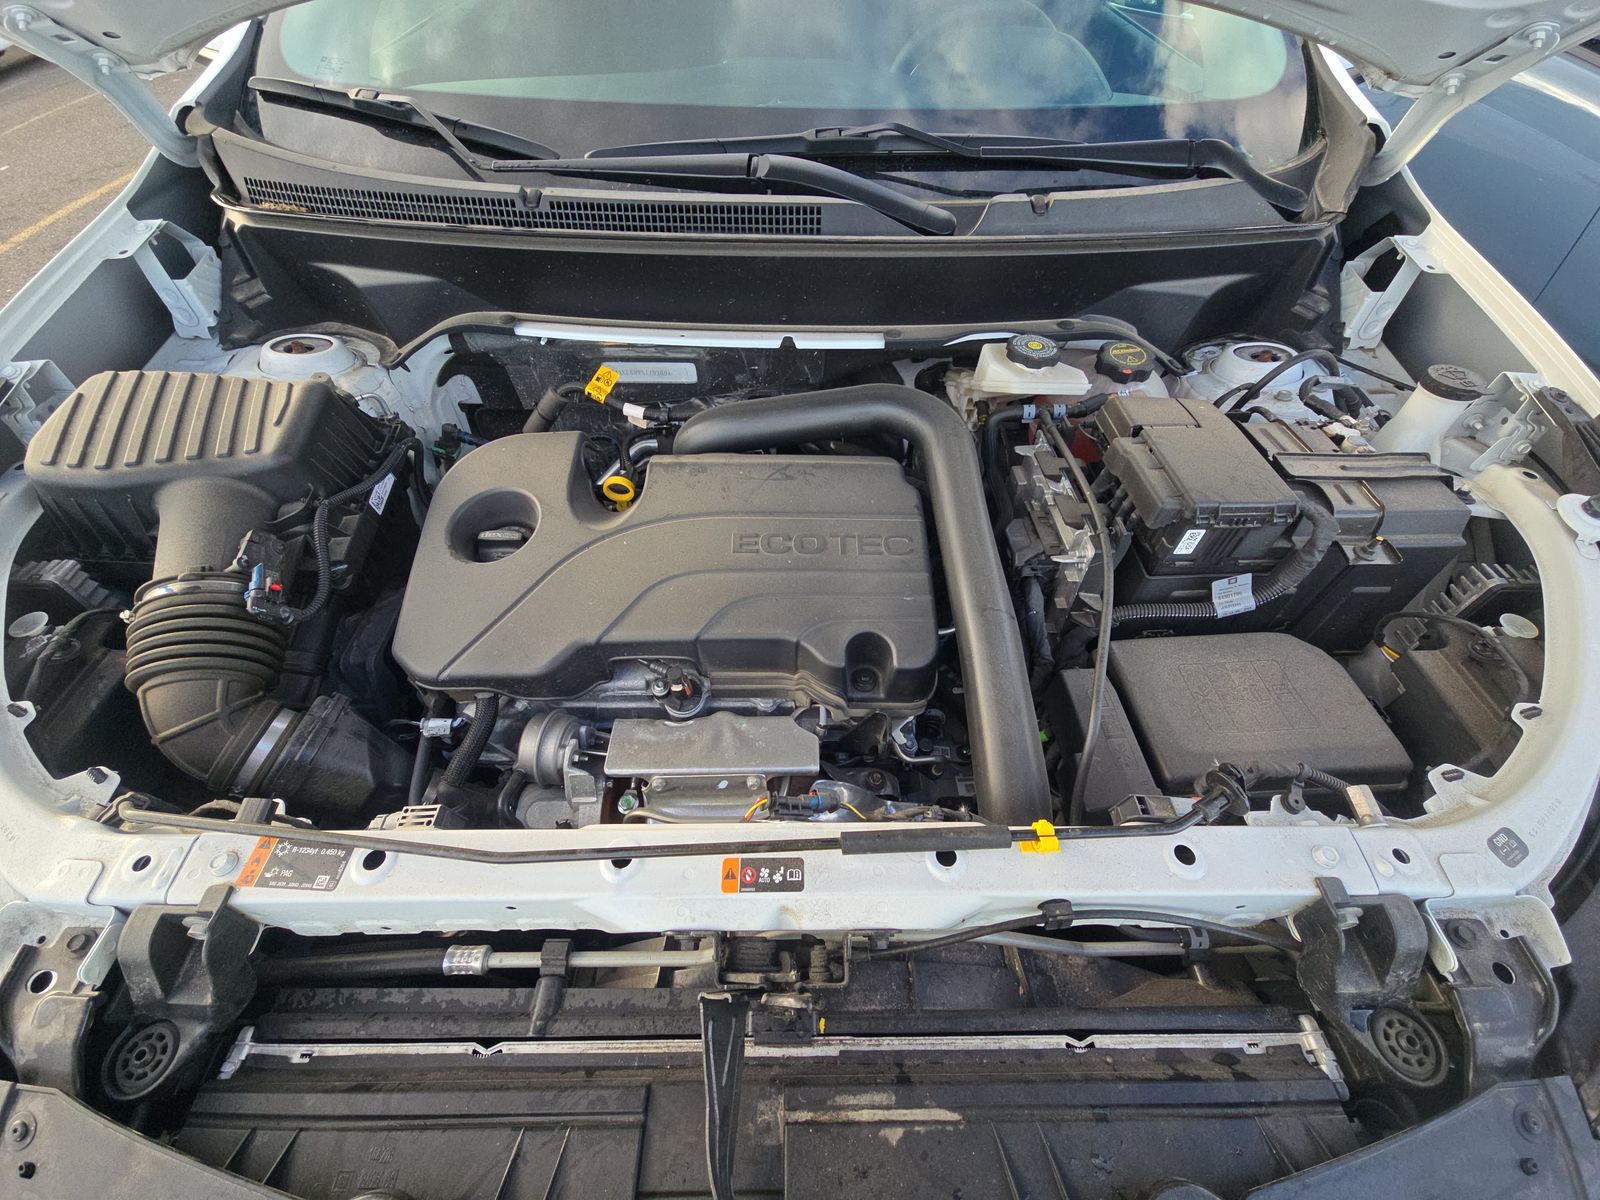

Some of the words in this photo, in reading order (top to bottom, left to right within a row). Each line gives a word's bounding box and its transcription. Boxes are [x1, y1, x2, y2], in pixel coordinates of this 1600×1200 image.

[731, 533, 914, 556] ECOTEC
[1493, 833, 1508, 847] GND
[292, 846, 319, 855] R-1234yf
[337, 849, 346, 858] kg
